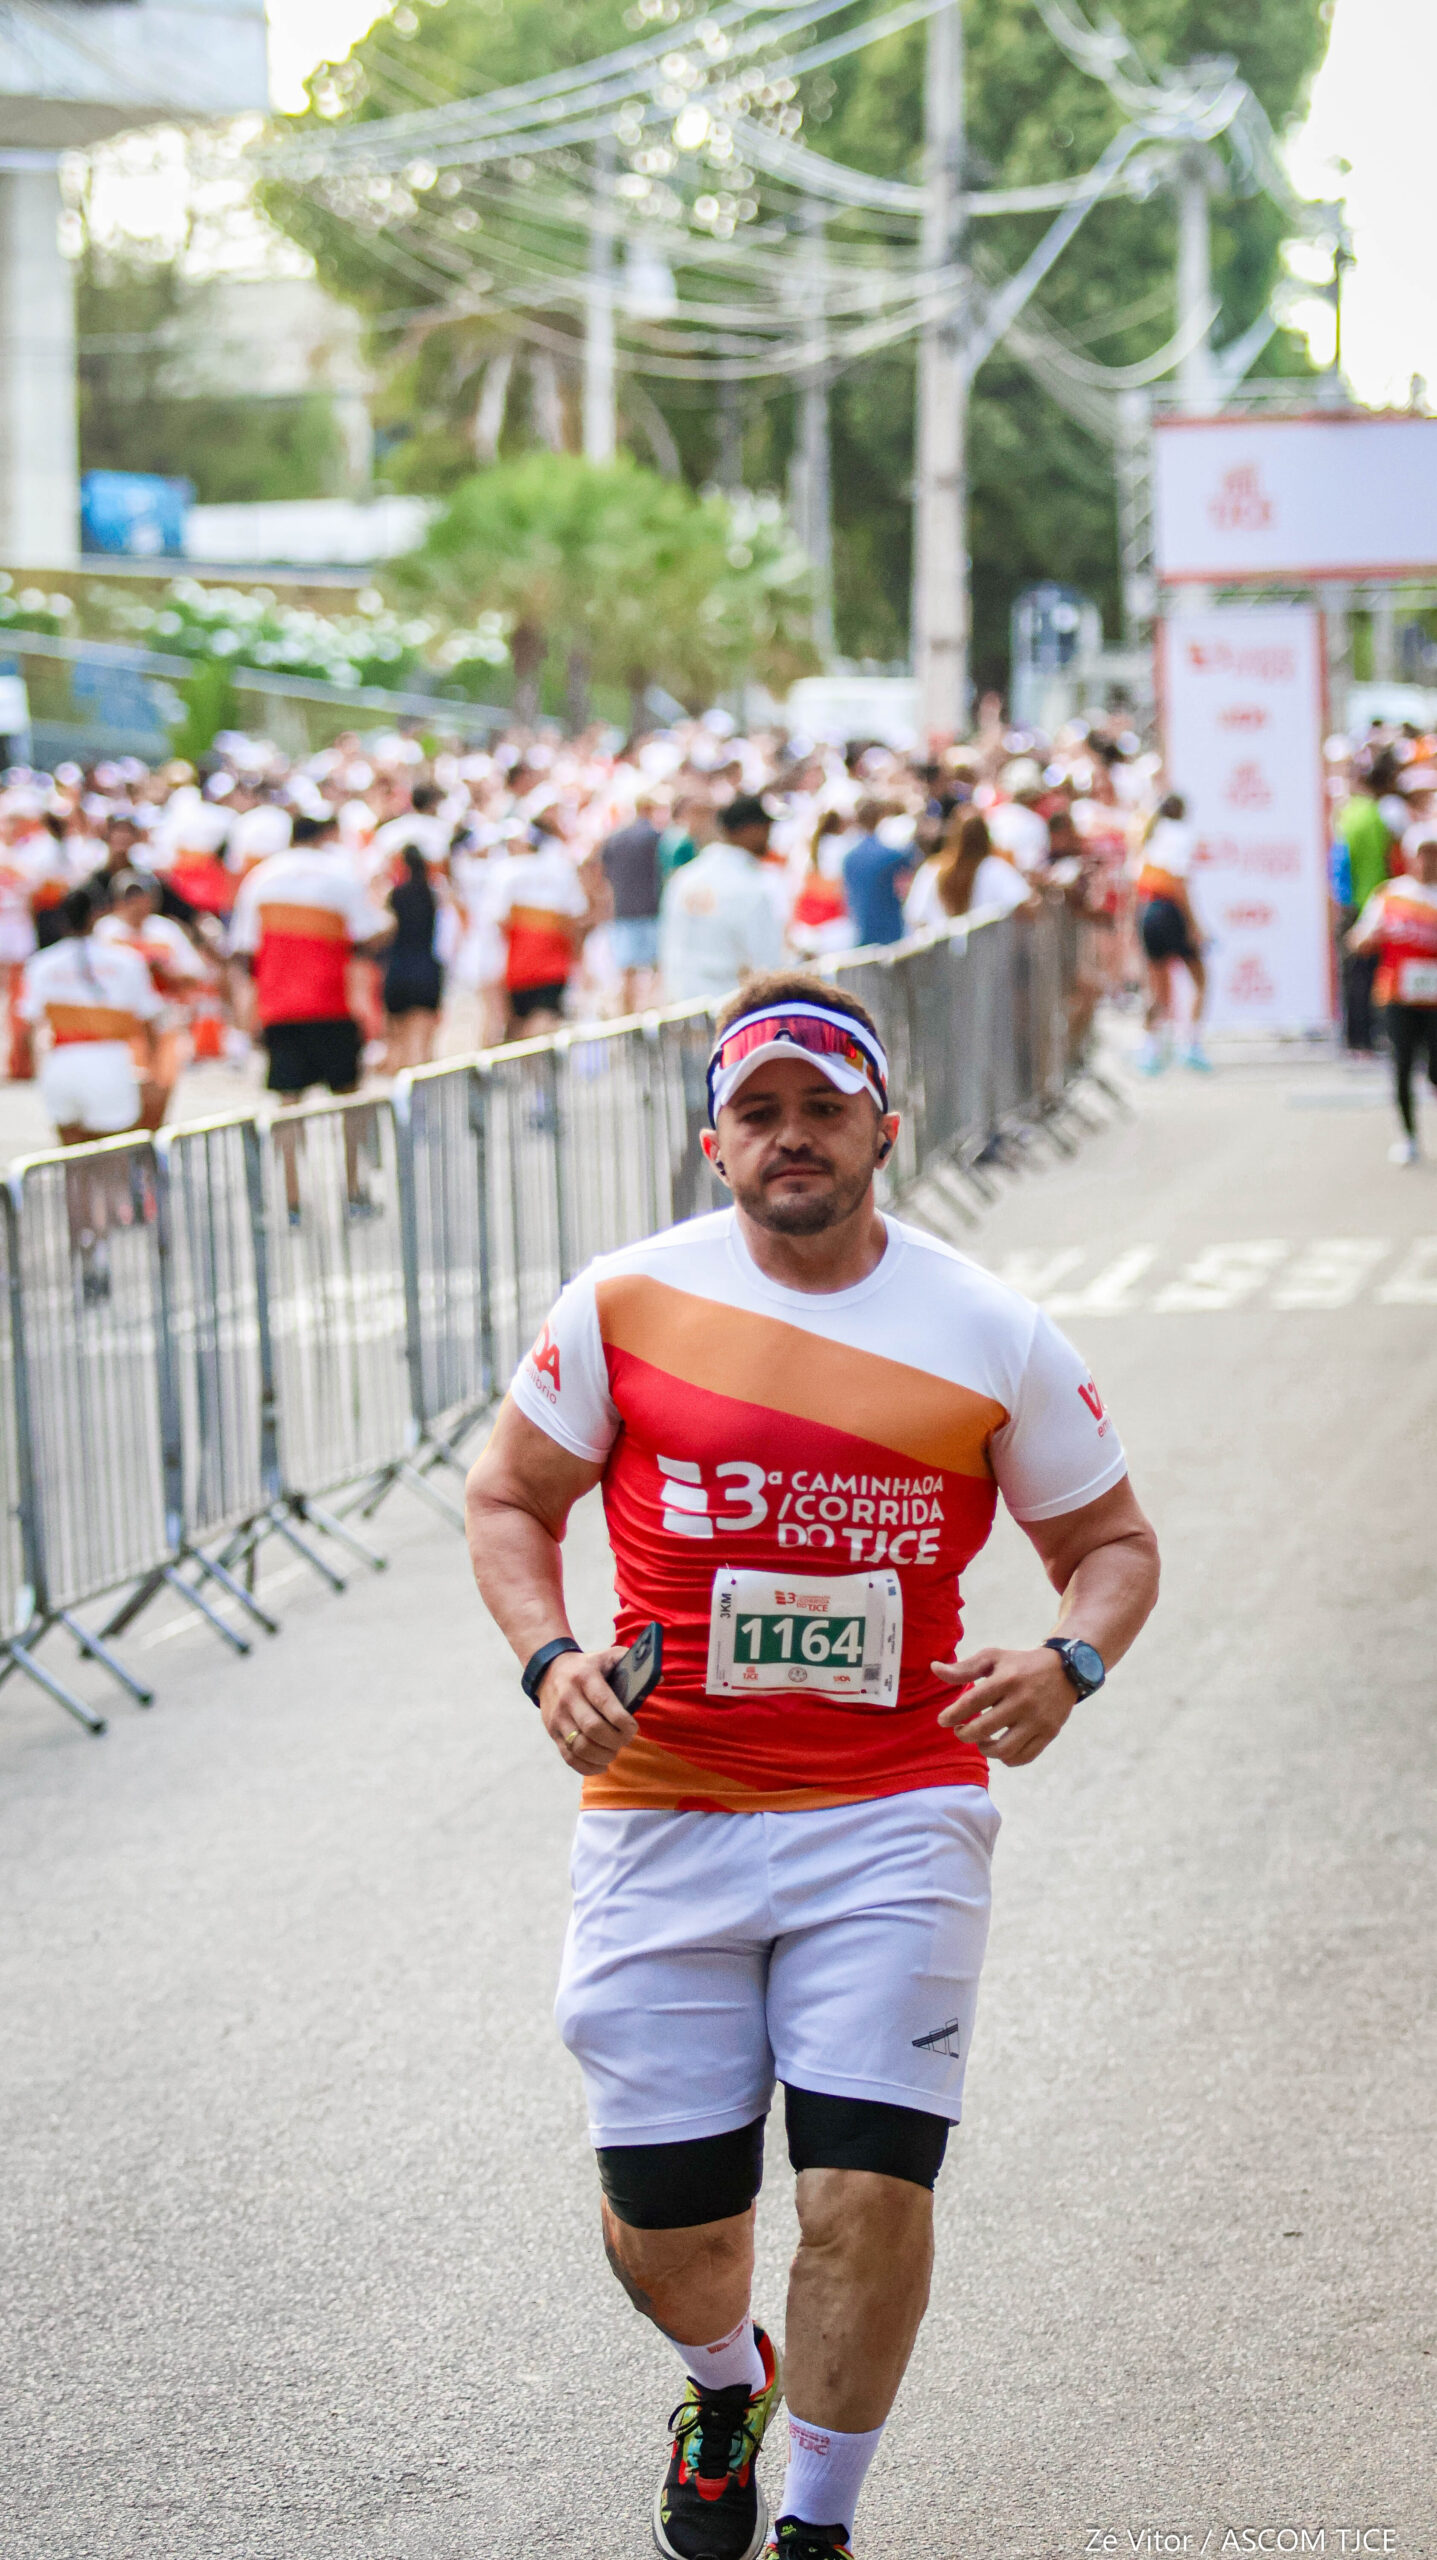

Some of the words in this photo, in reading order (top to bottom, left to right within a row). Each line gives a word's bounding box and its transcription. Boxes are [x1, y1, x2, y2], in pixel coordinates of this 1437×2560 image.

[791, 1471, 944, 1497] CAMINHADA
[777, 1523, 836, 1548] DO
[841, 1527, 941, 1565] TJCE
[720, 1593, 732, 1619] 3KM
[740, 1617, 863, 1663] 1164
